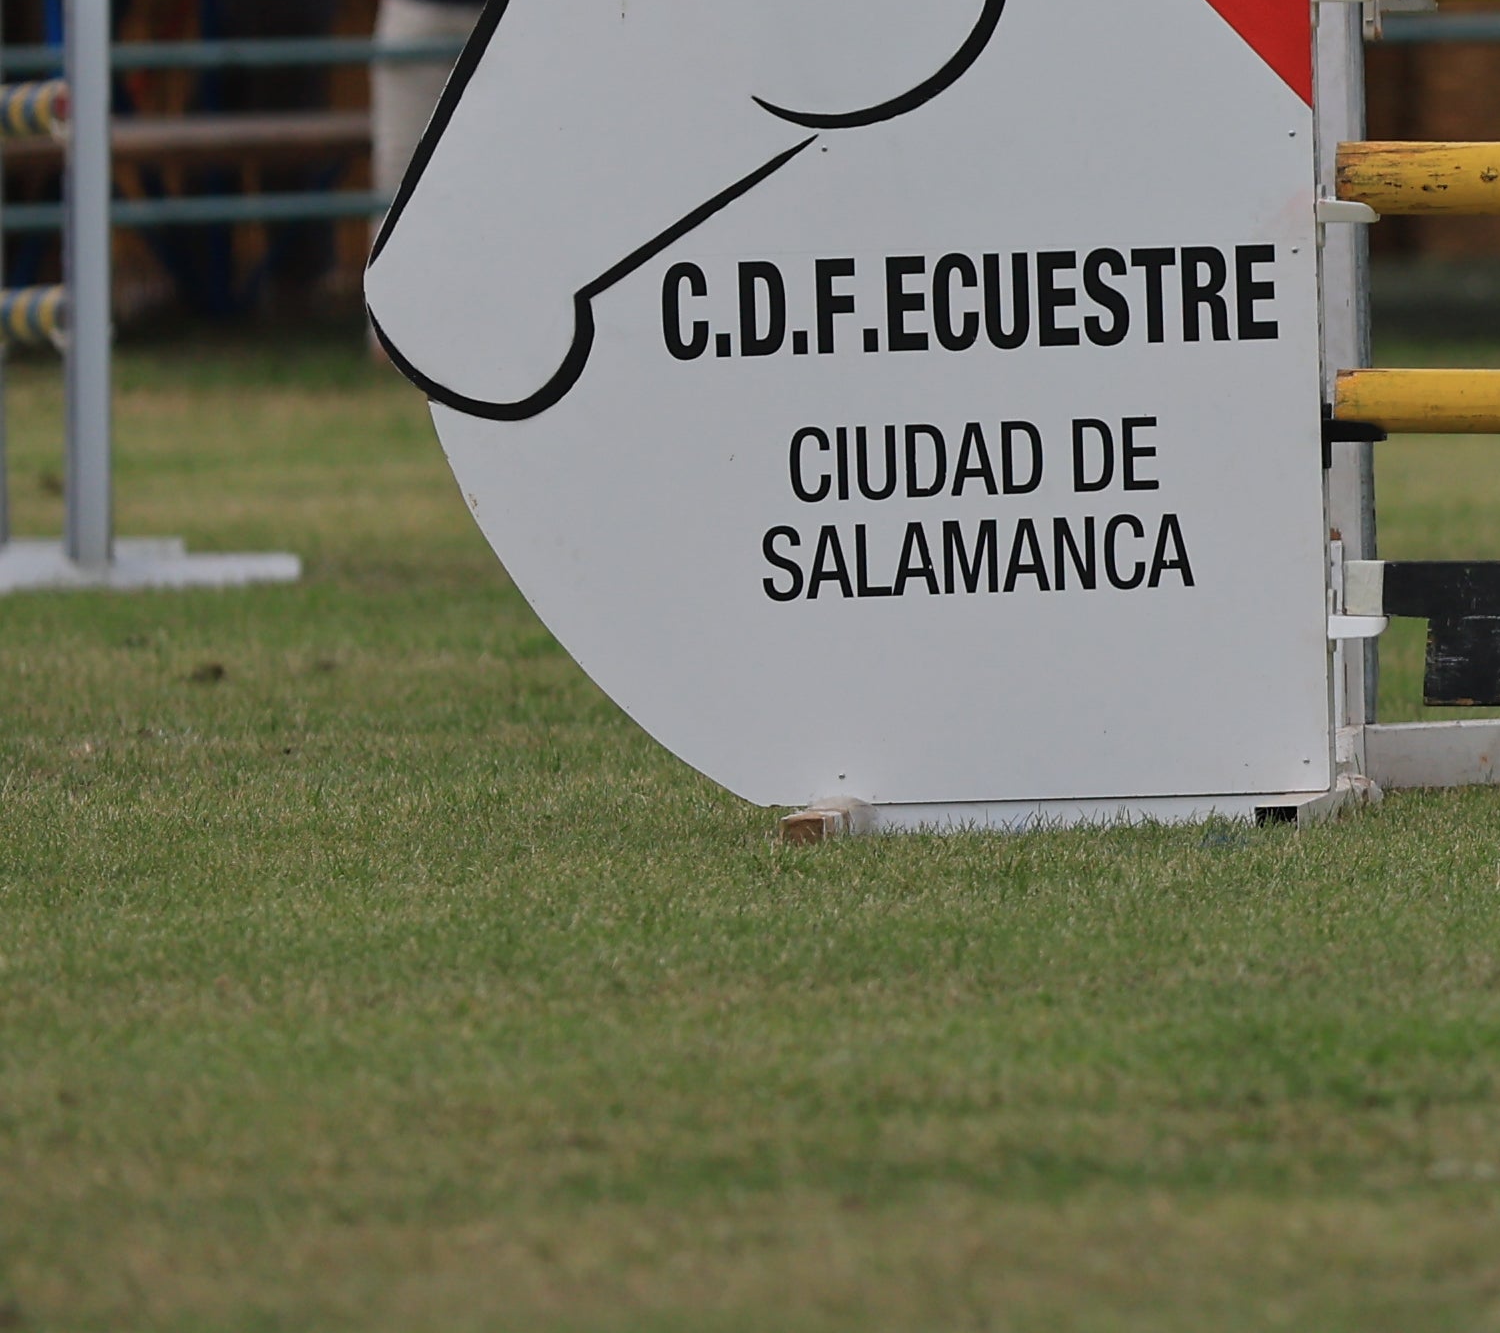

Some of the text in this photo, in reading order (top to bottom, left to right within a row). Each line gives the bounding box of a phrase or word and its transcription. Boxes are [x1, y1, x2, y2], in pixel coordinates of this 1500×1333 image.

[661, 244, 1279, 361] C.D.F.ECUESTRE
[788, 416, 1160, 503] CIUDAD DE
[761, 513, 1195, 603] SALAMANCA
